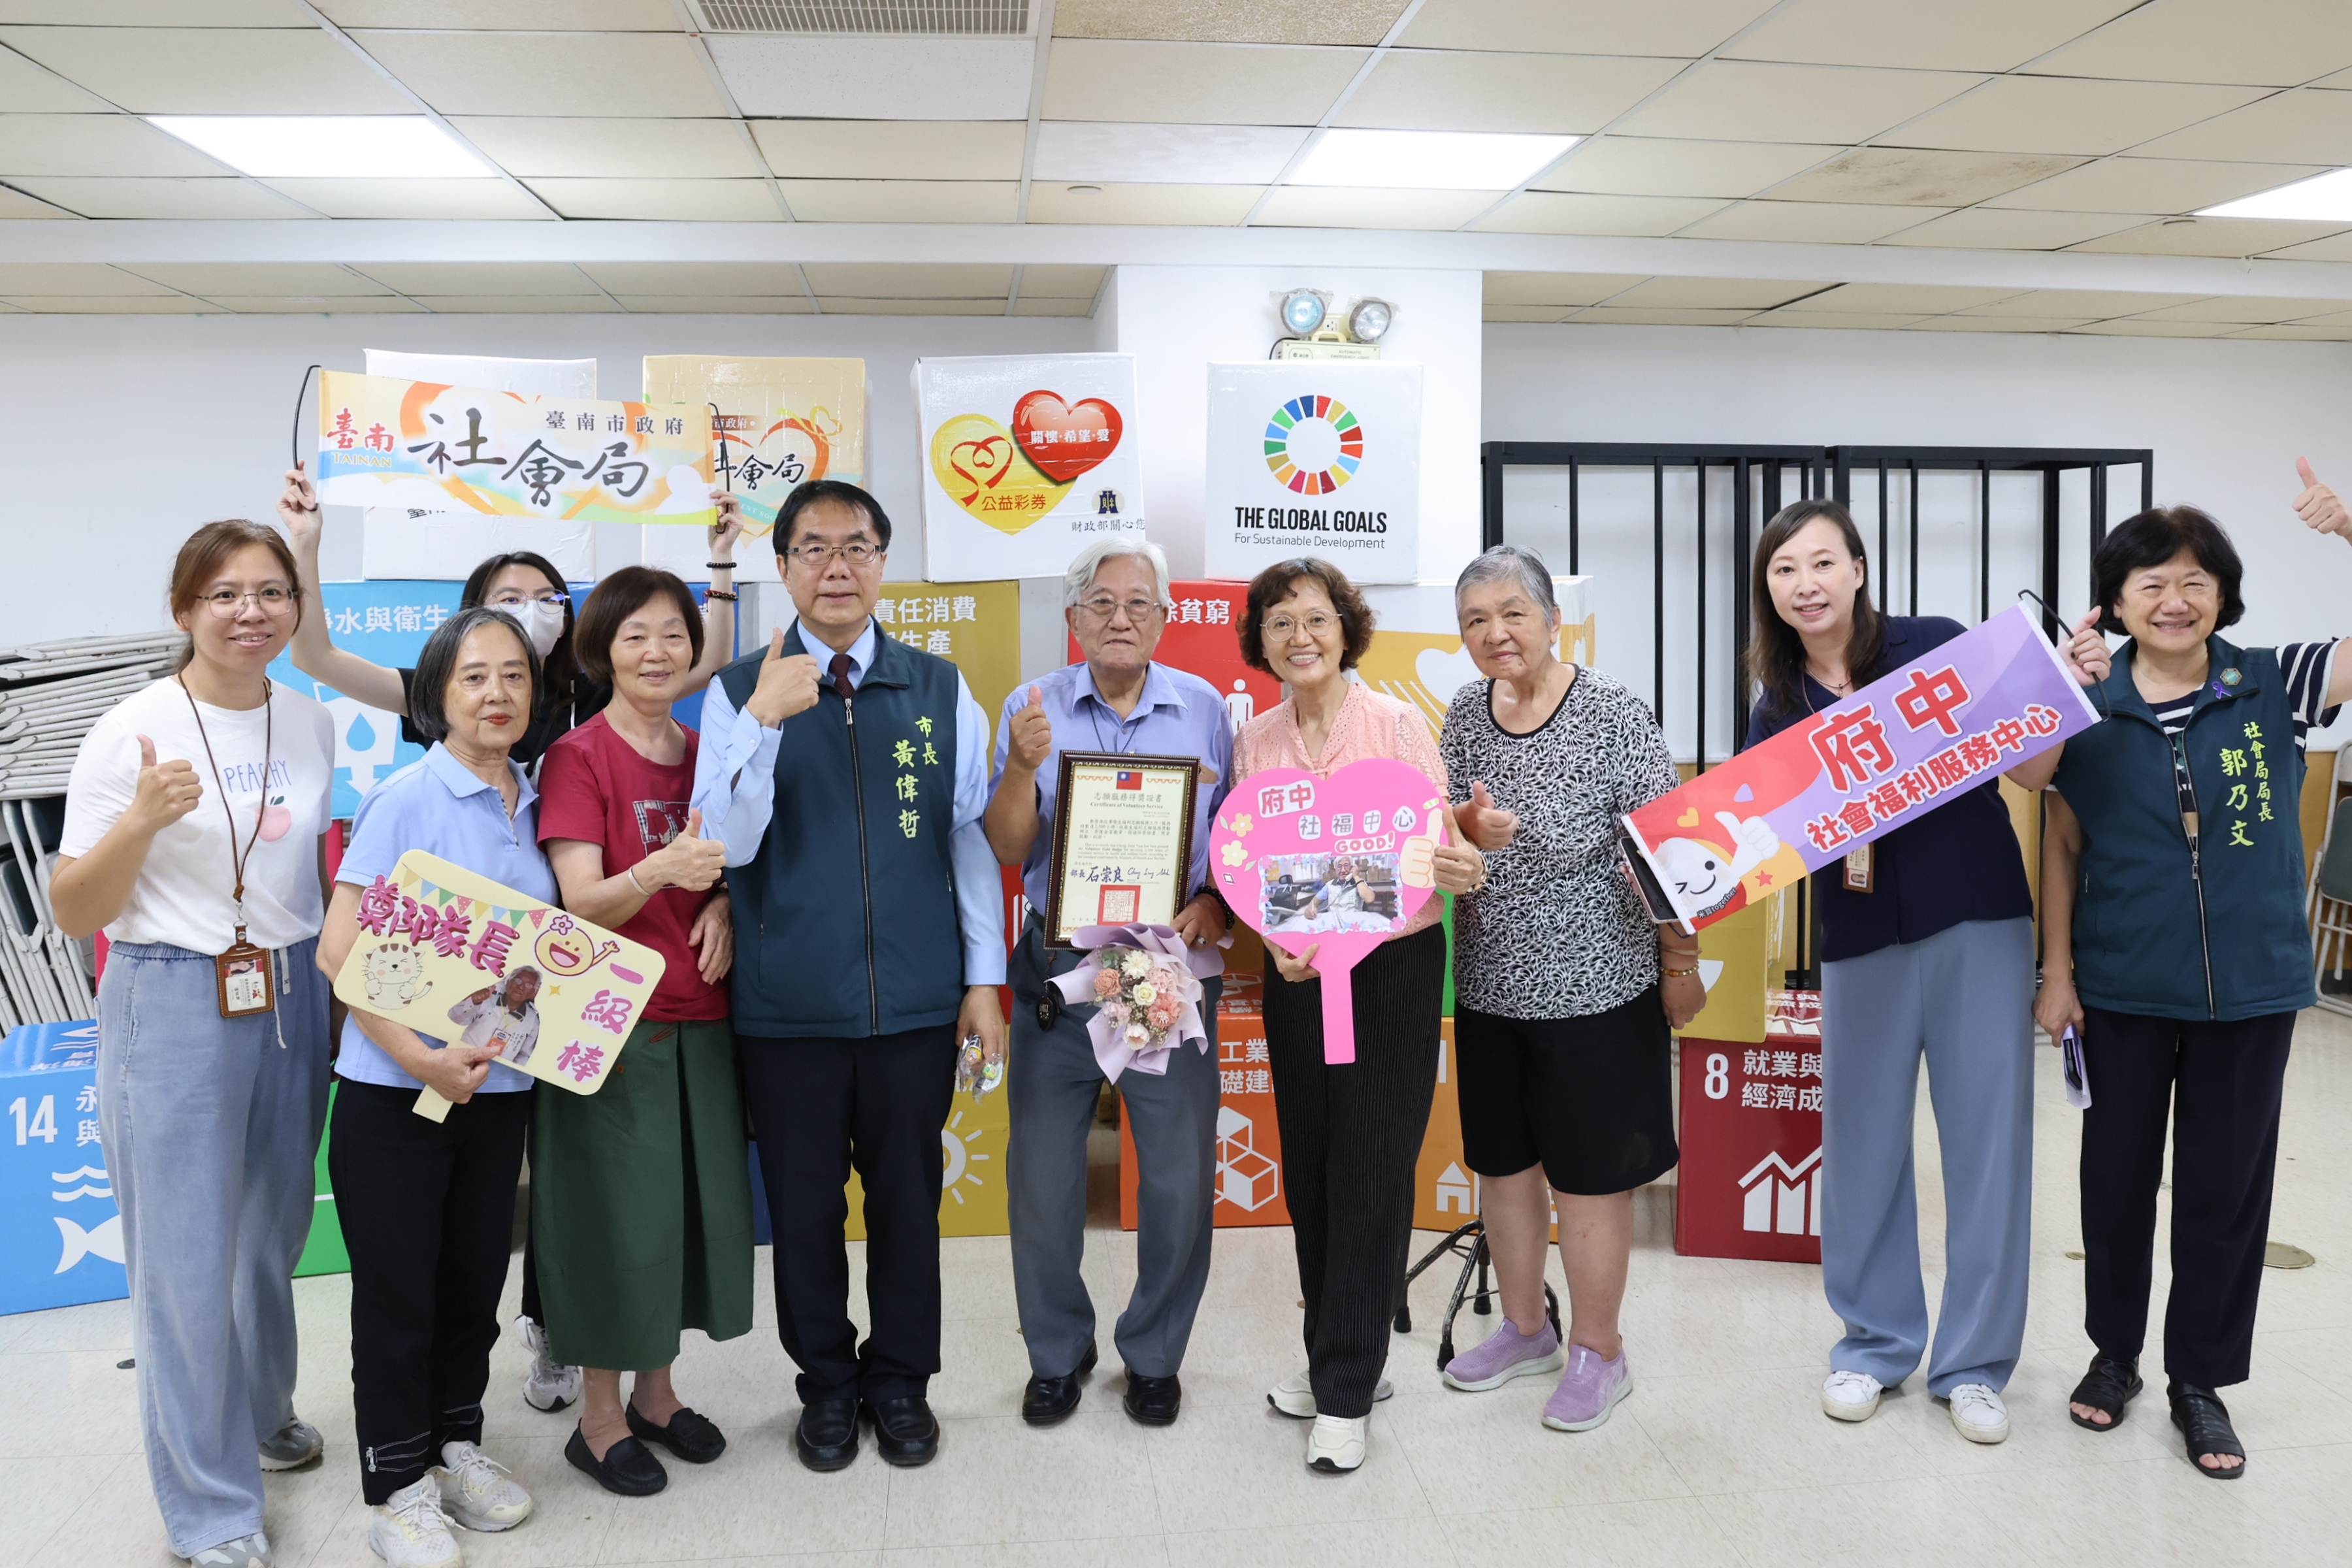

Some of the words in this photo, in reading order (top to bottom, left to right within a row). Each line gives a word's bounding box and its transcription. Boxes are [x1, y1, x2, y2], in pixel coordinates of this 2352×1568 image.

[327, 408, 395, 453] 臺南
[546, 410, 683, 435] 臺南市政府
[711, 417, 748, 429] 市政府
[331, 451, 392, 468] TAINAN
[407, 407, 649, 507] 社會局
[981, 494, 1047, 512] 公益彩券
[1071, 518, 1146, 533] 財政部關心您
[1235, 507, 1265, 529] THE
[1268, 508, 1330, 531] GLOBAL
[1333, 510, 1387, 533] GOALS
[1235, 532, 1251, 544] For
[1253, 533, 1312, 546] Sustainable
[1314, 536, 1386, 550] Development
[874, 595, 977, 625] 責任消費
[887, 629, 952, 655] 生產
[915, 716, 939, 766] 市長
[1812, 668, 1969, 791] 府中
[223, 760, 291, 793] PEACHY
[1808, 706, 2060, 851] 社會福利服務中心
[2244, 721, 2274, 822] 社會局局長
[892, 739, 921, 839] 黃偉哲
[1262, 785, 1311, 815] 府中
[2219, 748, 2255, 847] 郭乃文
[1299, 809, 1413, 837] 社福中心
[1335, 834, 1394, 853] GOOD!
[1085, 865, 1124, 883] 石崇良
[556, 962, 644, 1083] 一級棒
[1219, 1038, 1270, 1064] 工業
[1743, 1049, 1822, 1079] 就業與
[1219, 1068, 1275, 1095] 礎建
[1705, 1053, 1729, 1100] 8
[1741, 1081, 1822, 1112] 經濟成
[8, 1094, 59, 1147] 14
